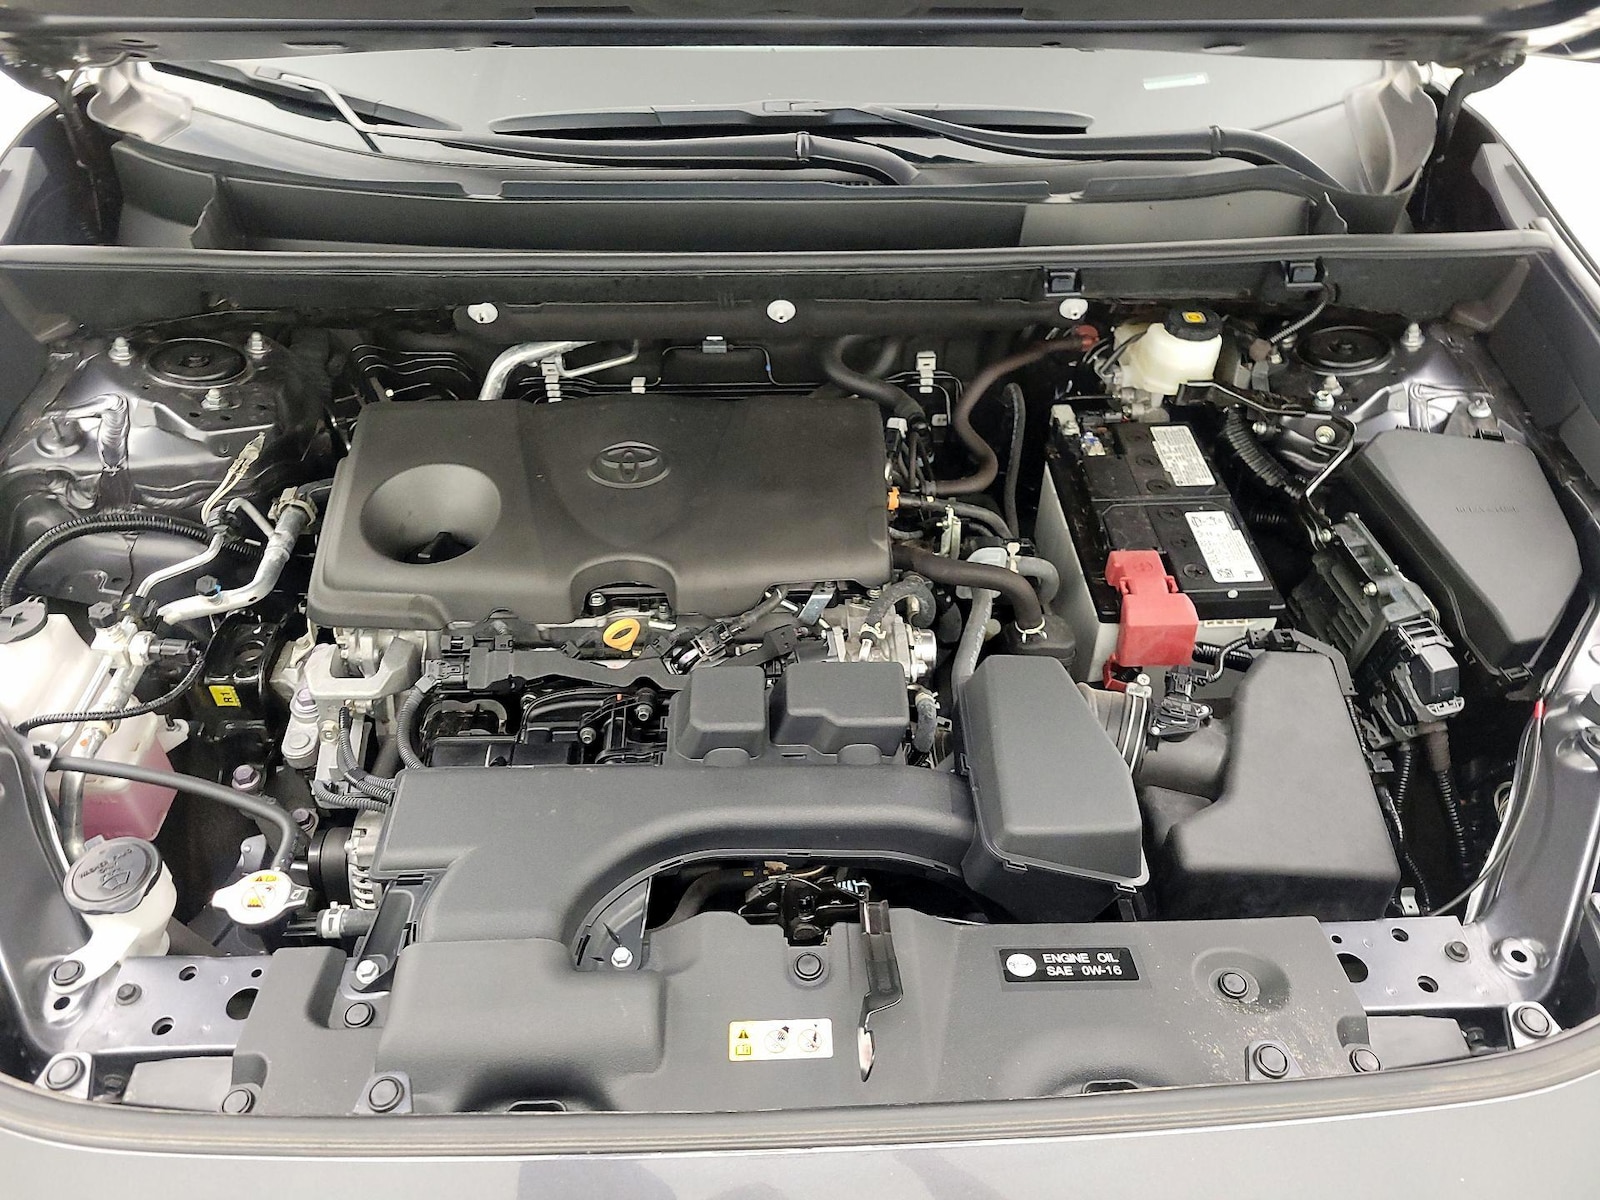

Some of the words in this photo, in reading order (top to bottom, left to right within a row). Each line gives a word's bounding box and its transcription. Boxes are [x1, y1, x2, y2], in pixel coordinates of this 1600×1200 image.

[1042, 953, 1091, 964] ENGINE
[1096, 952, 1120, 963] OIL
[1046, 965, 1075, 976] SAE
[1081, 965, 1123, 976] 0W-16
